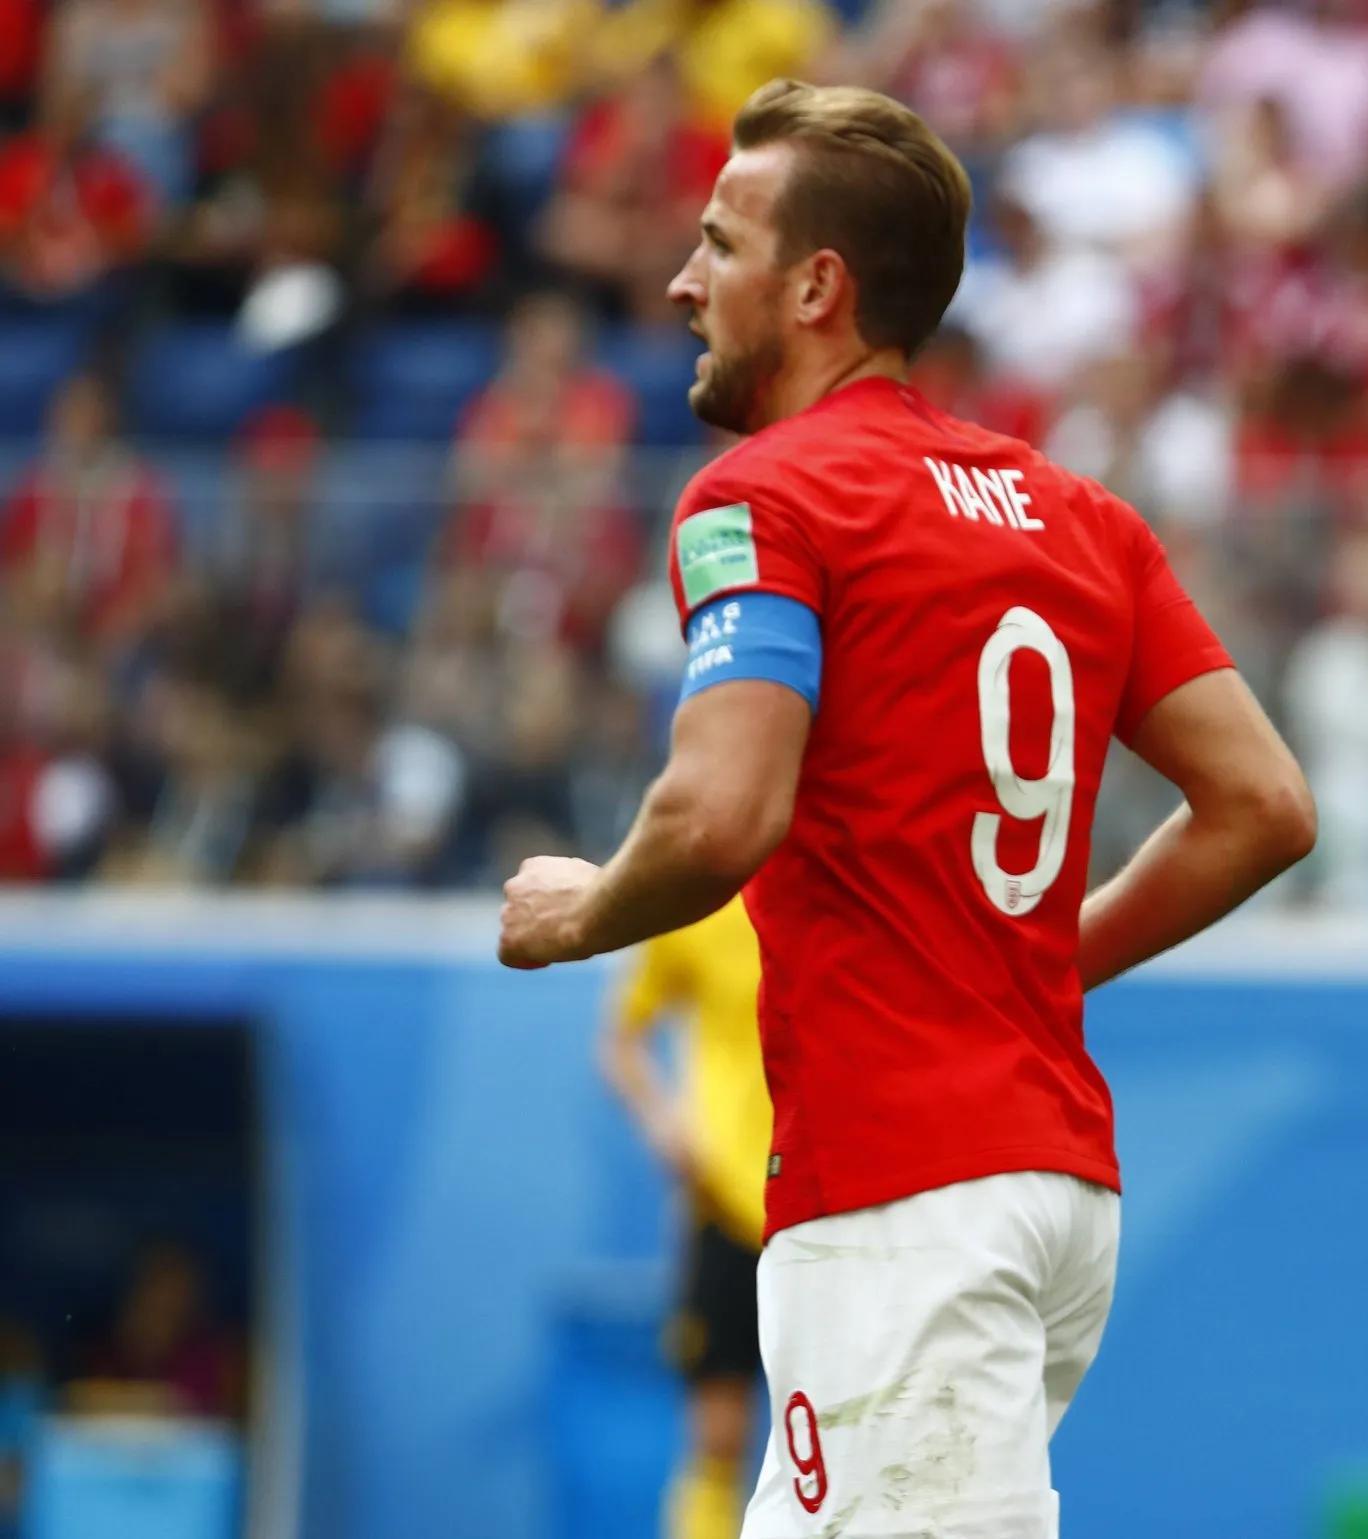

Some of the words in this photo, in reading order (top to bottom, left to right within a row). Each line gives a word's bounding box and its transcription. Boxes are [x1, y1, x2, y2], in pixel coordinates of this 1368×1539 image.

[923, 456, 1045, 531] KANE
[971, 606, 1075, 916] 9
[784, 1390, 828, 1514] 9
